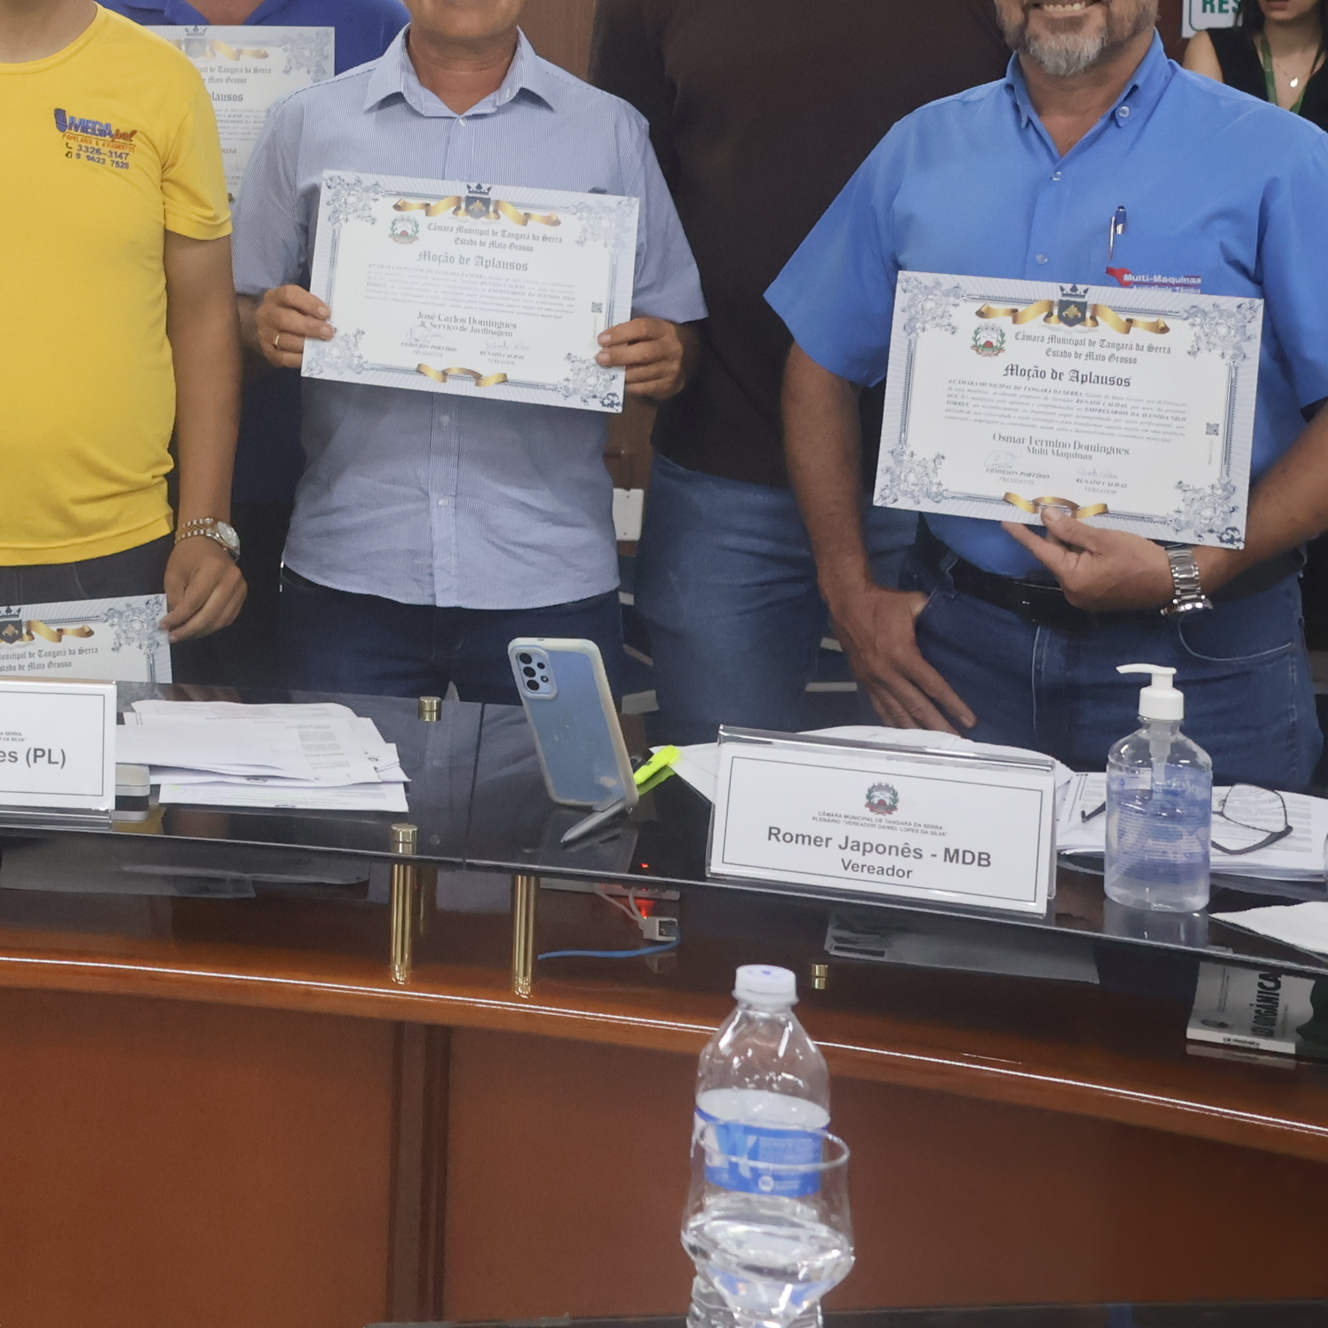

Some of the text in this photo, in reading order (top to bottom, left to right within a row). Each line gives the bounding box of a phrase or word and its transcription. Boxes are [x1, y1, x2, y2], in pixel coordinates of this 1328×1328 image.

[77, 144, 129, 161] 3326-3147
[416, 250, 529, 272] Moção de Aplausos
[1002, 363, 1131, 388] Moção de Aplausos
[25, 747, 67, 769] (PL)
[767, 825, 834, 850] Romer
[837, 834, 924, 861] Japonês
[943, 847, 992, 868] MDB
[841, 857, 914, 880] Vereador
